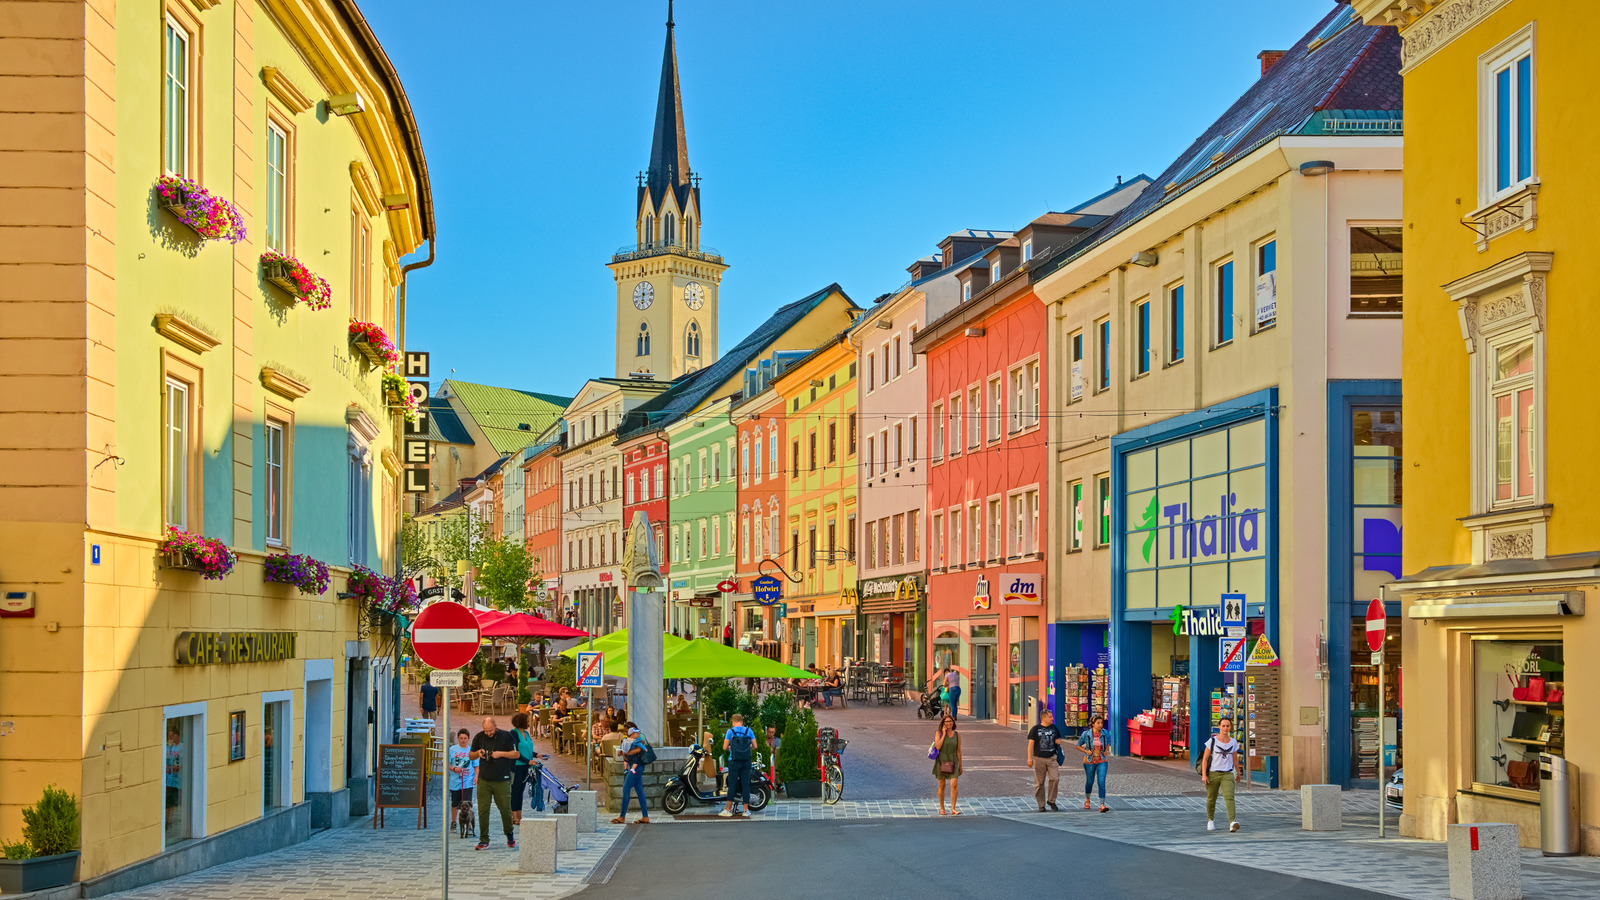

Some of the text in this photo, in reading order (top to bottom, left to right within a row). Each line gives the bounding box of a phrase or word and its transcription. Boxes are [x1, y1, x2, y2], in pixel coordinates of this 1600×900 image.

[408, 354, 427, 491] HOTEL
[1164, 492, 1258, 560] Thalia
[95, 548, 98, 558] 1
[977, 575, 987, 596] dm
[1010, 578, 1035, 593] dm
[1182, 608, 1225, 636] Thalia
[187, 632, 298, 665] CAFE RESTAURANT
